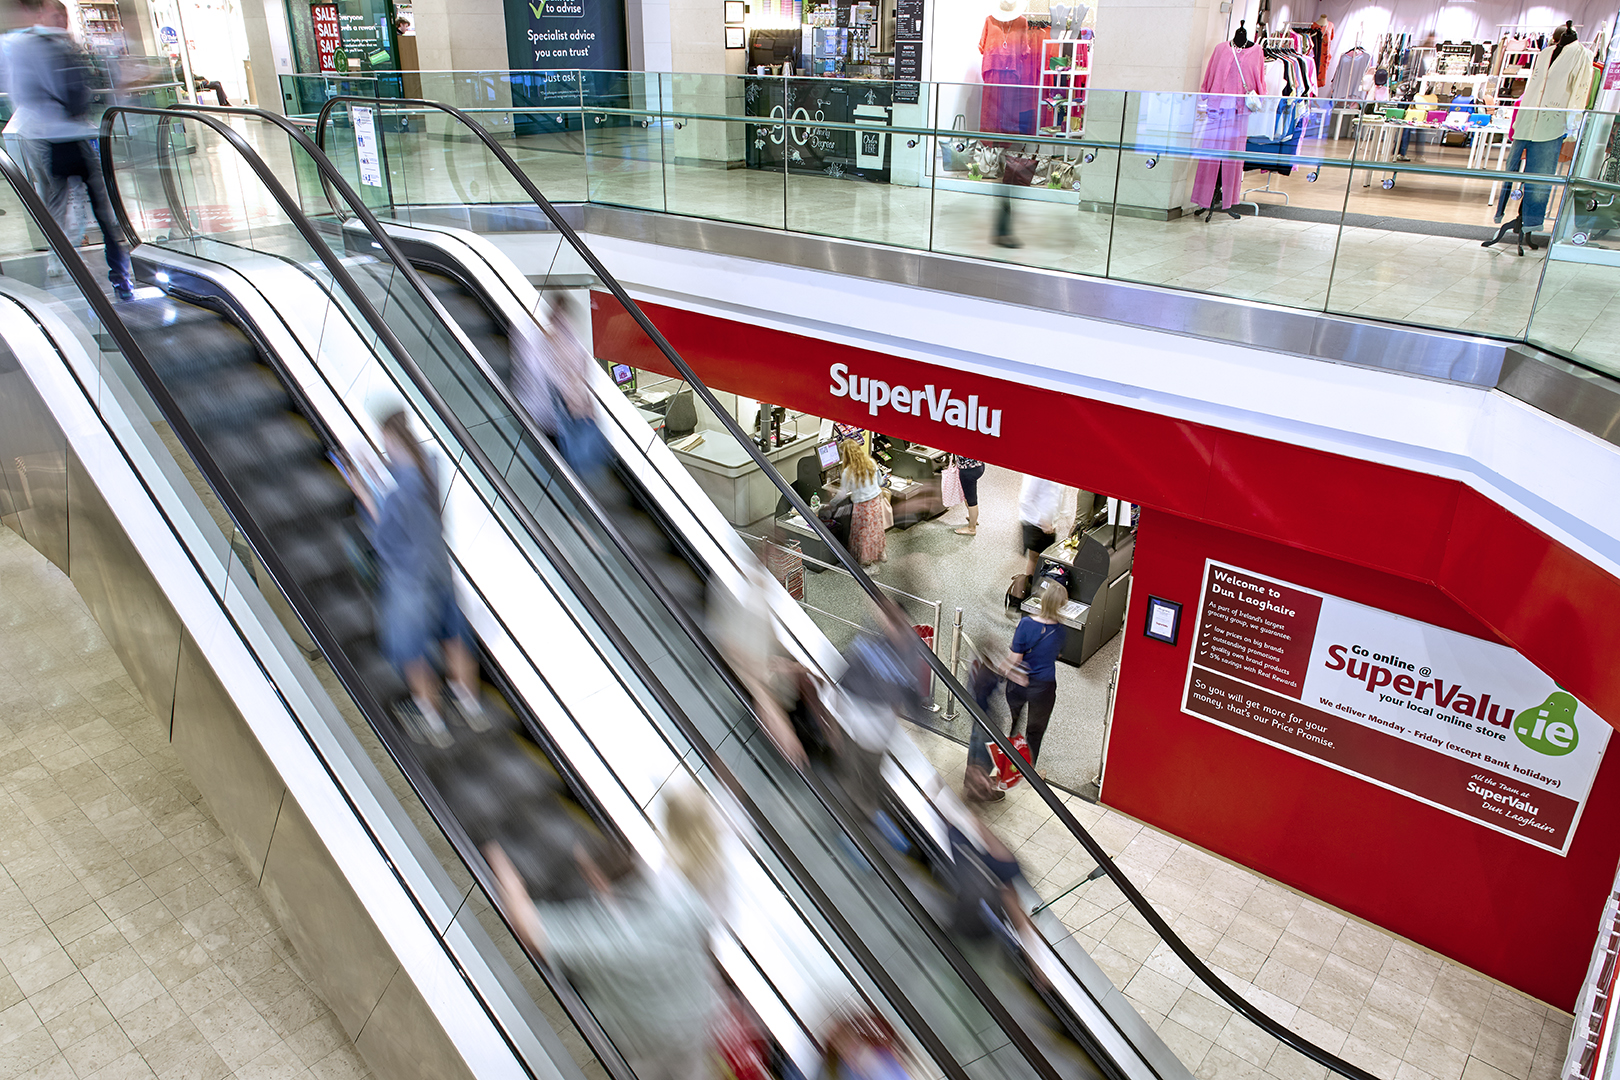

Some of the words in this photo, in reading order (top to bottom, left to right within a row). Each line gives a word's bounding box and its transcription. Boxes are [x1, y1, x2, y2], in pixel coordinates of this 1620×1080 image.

[315, 7, 337, 21] SALE
[545, 4, 555, 13] to
[556, 2, 582, 13] advise
[317, 23, 339, 37] SALE
[527, 29, 568, 45] Specialist
[569, 29, 596, 40] advice
[322, 55, 336, 69] SA
[534, 49, 550, 61] you
[552, 49, 568, 57] can
[543, 71, 561, 83] Just
[562, 71, 576, 82] ask
[829, 362, 1002, 438] SuperValu
[1214, 569, 1266, 594] Welcome
[1268, 588, 1281, 598] to
[1212, 583, 1235, 599] Dun
[1238, 591, 1296, 618] Laoghaire
[1207, 609, 1229, 621] grocery
[1230, 617, 1249, 628] group,
[1217, 605, 1230, 613] part
[1231, 609, 1239, 617] of
[1239, 610, 1263, 624] Ireland's
[1264, 619, 1285, 630] largest
[1212, 636, 1246, 653] outstanding
[1247, 647, 1280, 662] promotions
[1214, 626, 1225, 634] low
[1225, 631, 1243, 641] prices
[1253, 639, 1263, 648] big
[1263, 642, 1284, 654] brands
[1209, 652, 1220, 661] 5%
[1221, 658, 1242, 669] savings
[1243, 664, 1257, 674] with
[1257, 669, 1271, 679] Real
[1272, 674, 1297, 688] Rewards
[1211, 645, 1231, 657] quality
[1231, 652, 1245, 660] own
[1245, 655, 1263, 667] brand
[1263, 662, 1290, 676] products
[1351, 644, 1370, 657] Go
[1372, 652, 1415, 672] online
[1418, 666, 1432, 678] @
[1194, 679, 1206, 690] So
[1208, 685, 1225, 697] you
[1228, 691, 1244, 704] will
[1245, 700, 1261, 710] get
[1262, 705, 1287, 719] more
[1287, 713, 1303, 724] for
[1305, 721, 1328, 733] your
[1379, 693, 1404, 707] your
[1406, 700, 1434, 717] local
[1436, 711, 1473, 730] online
[1475, 724, 1507, 742] store
[1193, 691, 1224, 710] money,
[1226, 703, 1251, 718] that's
[1253, 714, 1269, 724] our
[1271, 718, 1294, 734] Price
[1296, 727, 1336, 750] Promise.
[1319, 696, 1333, 708] We
[1335, 703, 1367, 719] deliver
[1367, 714, 1406, 734] Monday
[1413, 730, 1444, 747] Friday
[1445, 741, 1482, 760] (except
[1484, 754, 1511, 770] Bank
[1512, 764, 1562, 788] holidays)
[1466, 781, 1540, 816] SuperValu
[1470, 773, 1485, 782] All
[1484, 777, 1497, 787] the
[1499, 782, 1520, 795] Team
[1520, 791, 1531, 799] at
[1481, 801, 1503, 815] Dun
[1504, 810, 1556, 834] Laoghaire
